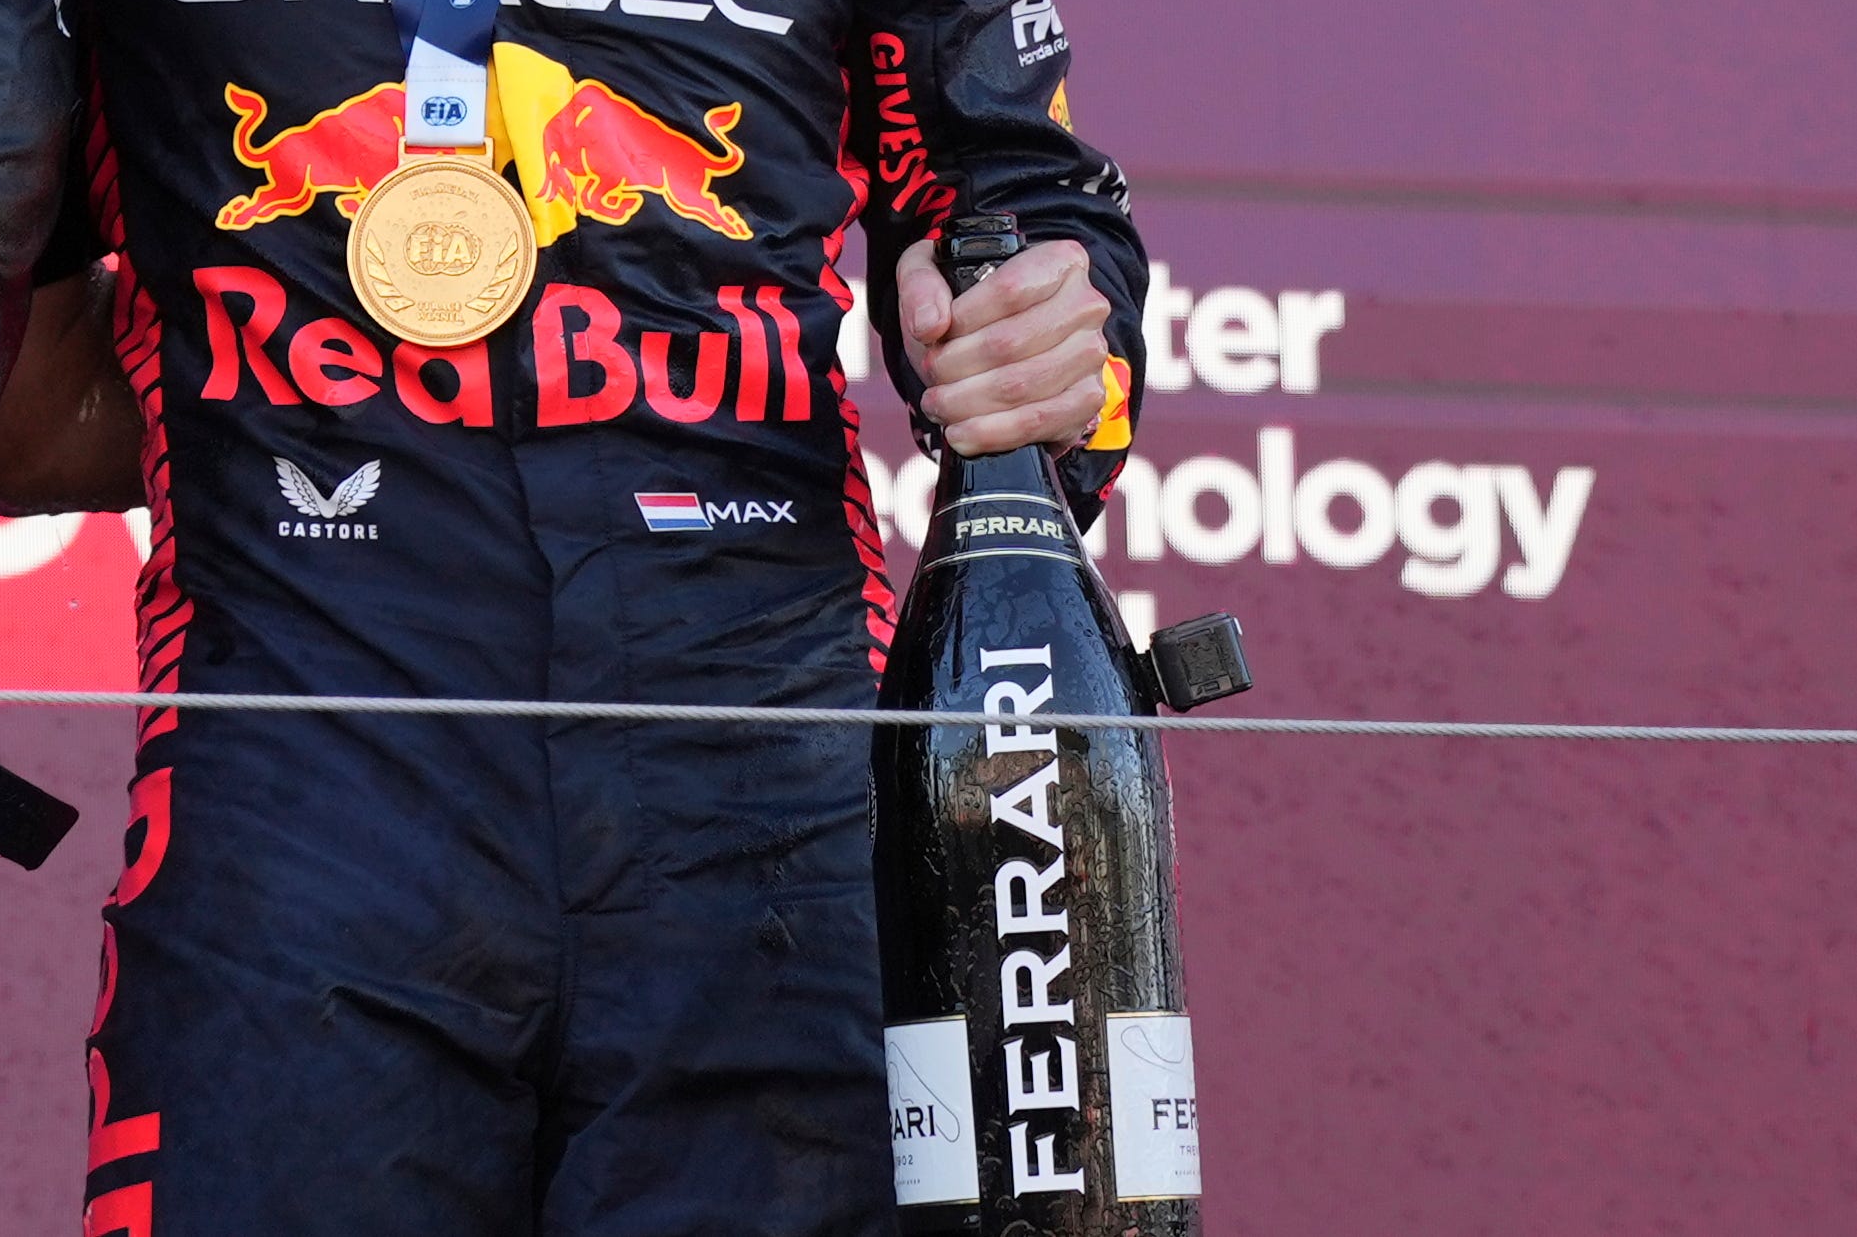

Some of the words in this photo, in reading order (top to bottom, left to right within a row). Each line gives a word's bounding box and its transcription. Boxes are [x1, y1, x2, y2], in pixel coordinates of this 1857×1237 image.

[870, 31, 928, 183] GIVES
[192, 265, 494, 428] Red
[532, 282, 812, 428] Bull
[278, 521, 380, 540] CASTORE
[705, 500, 798, 524] MAX
[955, 516, 1065, 541] FERRARI
[980, 643, 1086, 1199] FERRARI
